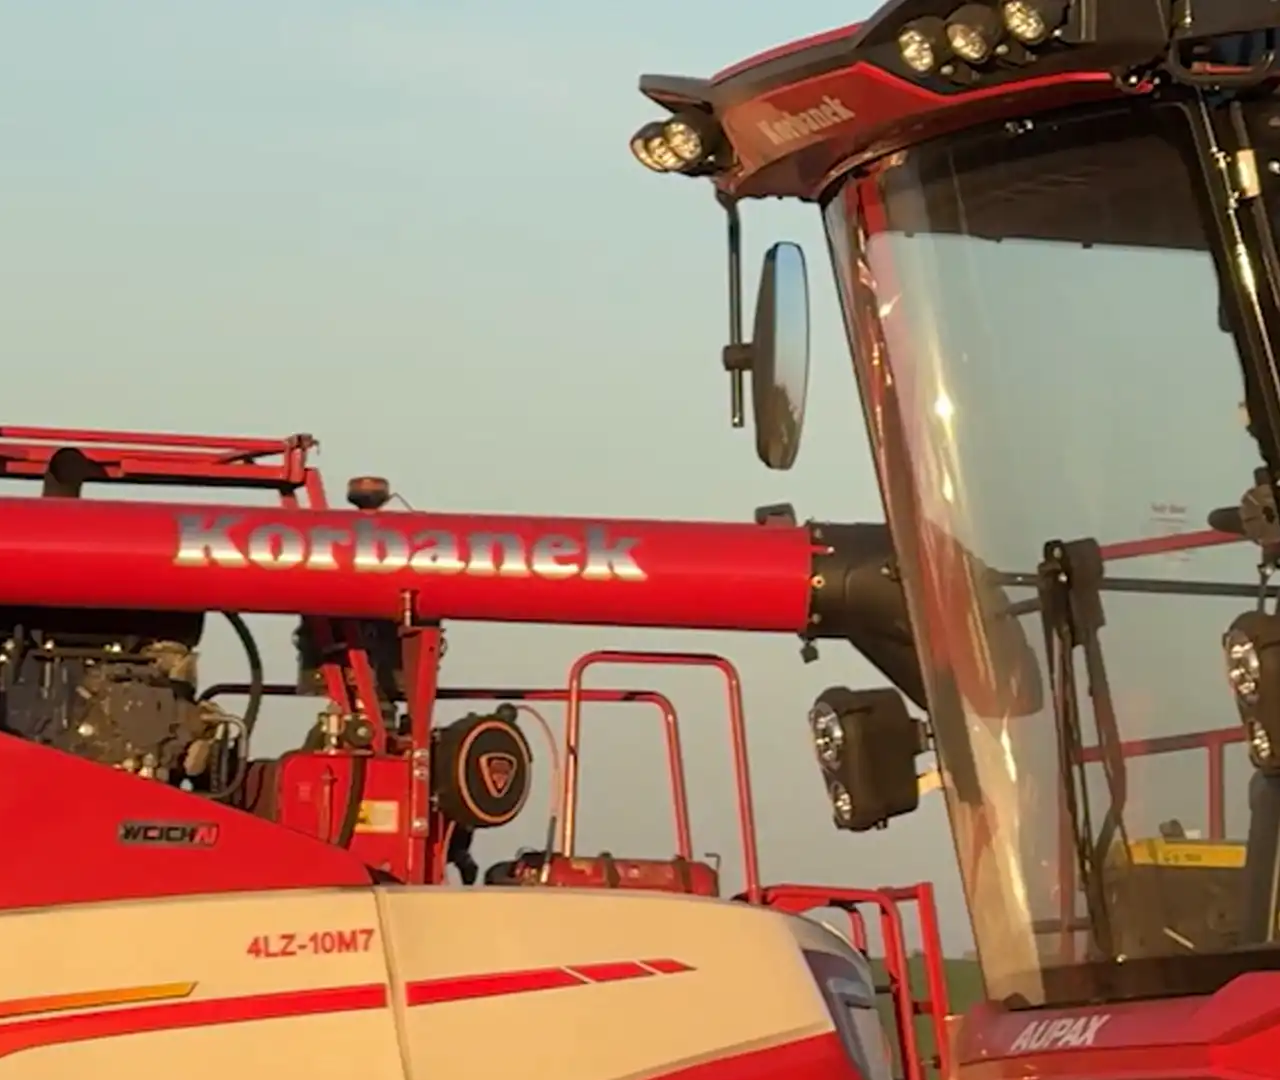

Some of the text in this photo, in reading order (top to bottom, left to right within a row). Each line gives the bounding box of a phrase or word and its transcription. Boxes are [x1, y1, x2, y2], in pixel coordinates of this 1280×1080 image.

[173, 513, 648, 581] Korbanek
[247, 928, 375, 958] 4LZ-10M7
[1009, 1015, 1110, 1053] AUPAX
